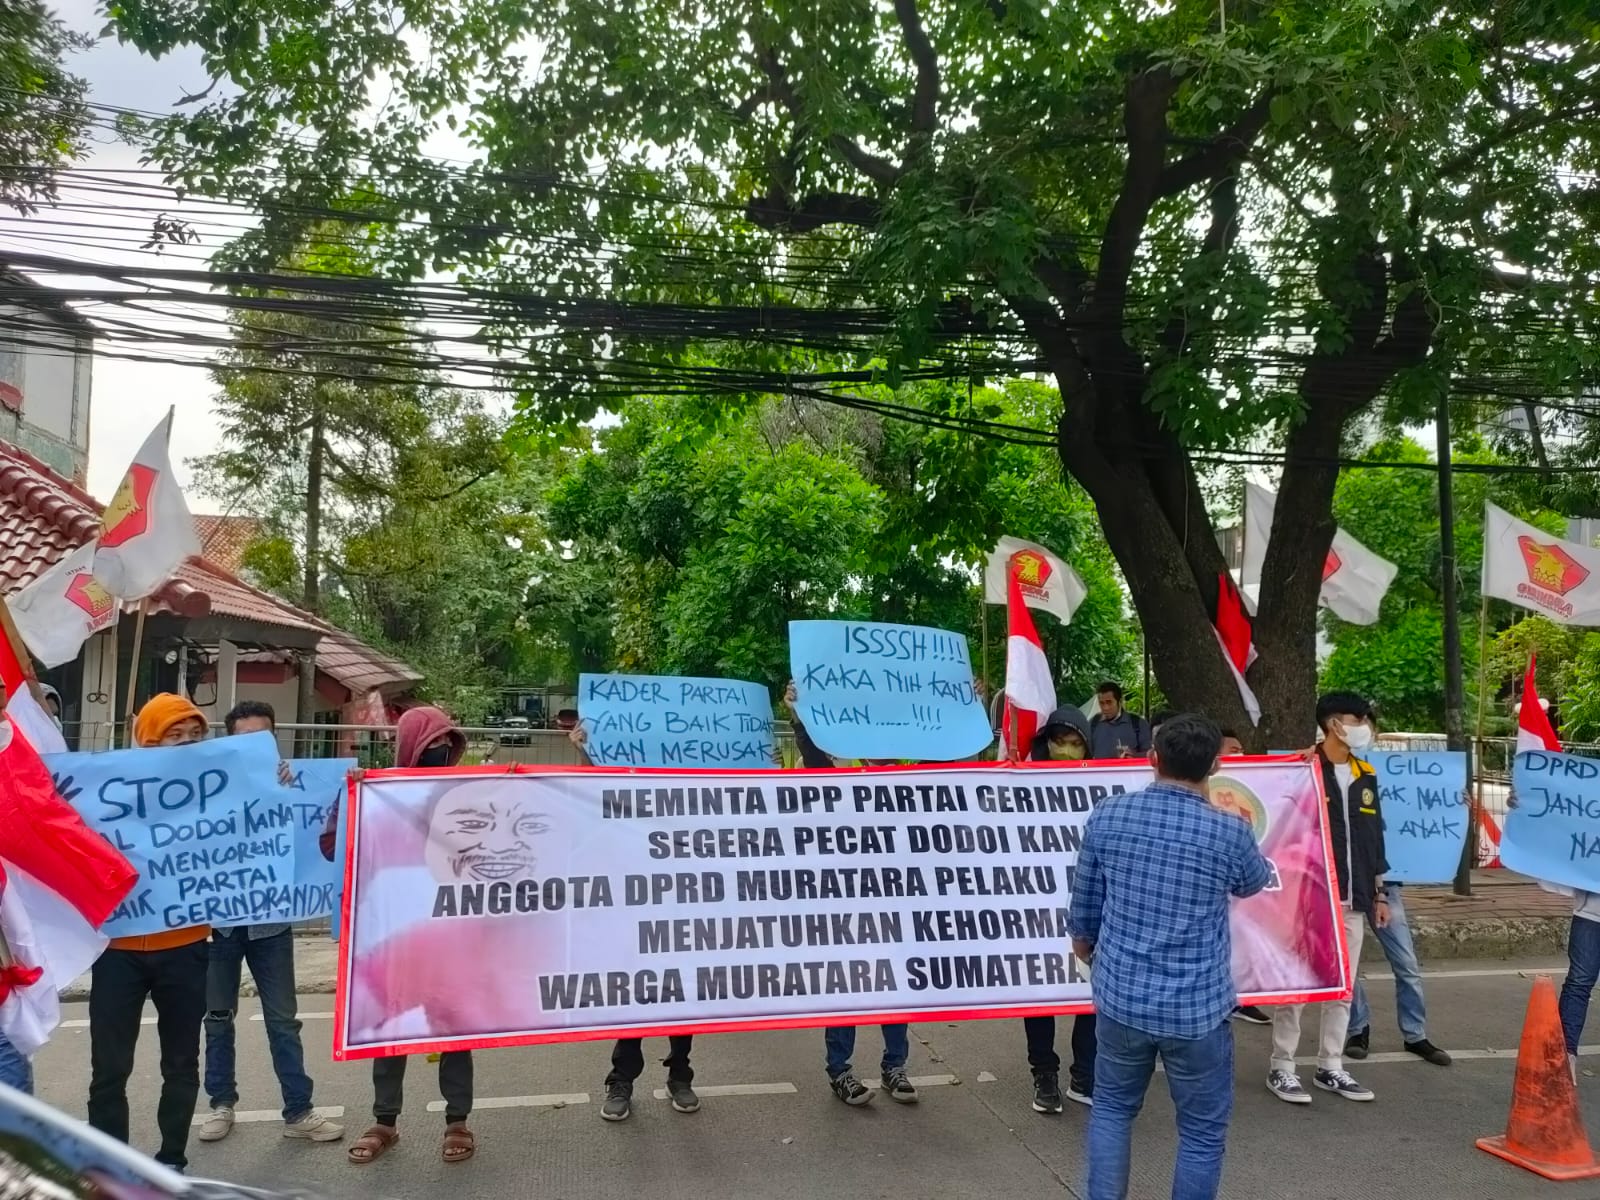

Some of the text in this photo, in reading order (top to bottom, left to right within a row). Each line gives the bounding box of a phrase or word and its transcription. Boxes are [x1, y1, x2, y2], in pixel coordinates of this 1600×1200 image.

[589, 678, 748, 706] KADER PARTAI
[803, 663, 876, 692] KAKA
[883, 669, 922, 693] NIH
[583, 710, 651, 735] YANG
[665, 711, 732, 734] BAIK
[588, 738, 772, 765] AKAN MERUSAK
[1386, 755, 1443, 776] GILO
[1524, 751, 1599, 779] DPRD
[98, 769, 229, 822] STOP
[602, 786, 768, 819] MEMINTA
[776, 785, 842, 815] DPP
[852, 785, 968, 813] PARTAI
[648, 824, 1087, 860] SEGERA PECAT DODOI KAN
[1398, 815, 1461, 839] ANAK
[147, 833, 291, 880] MENCORENG
[178, 864, 277, 901] PARTAI
[432, 874, 614, 918] ANGGOTA
[624, 871, 725, 907] DPRD
[736, 866, 929, 902] MURATARA
[934, 865, 1057, 896] PELAKU
[638, 907, 1071, 954] MENJATUHKAN KEHORMA
[538, 952, 1087, 1012] WARGA MURATARA SUMATERA
